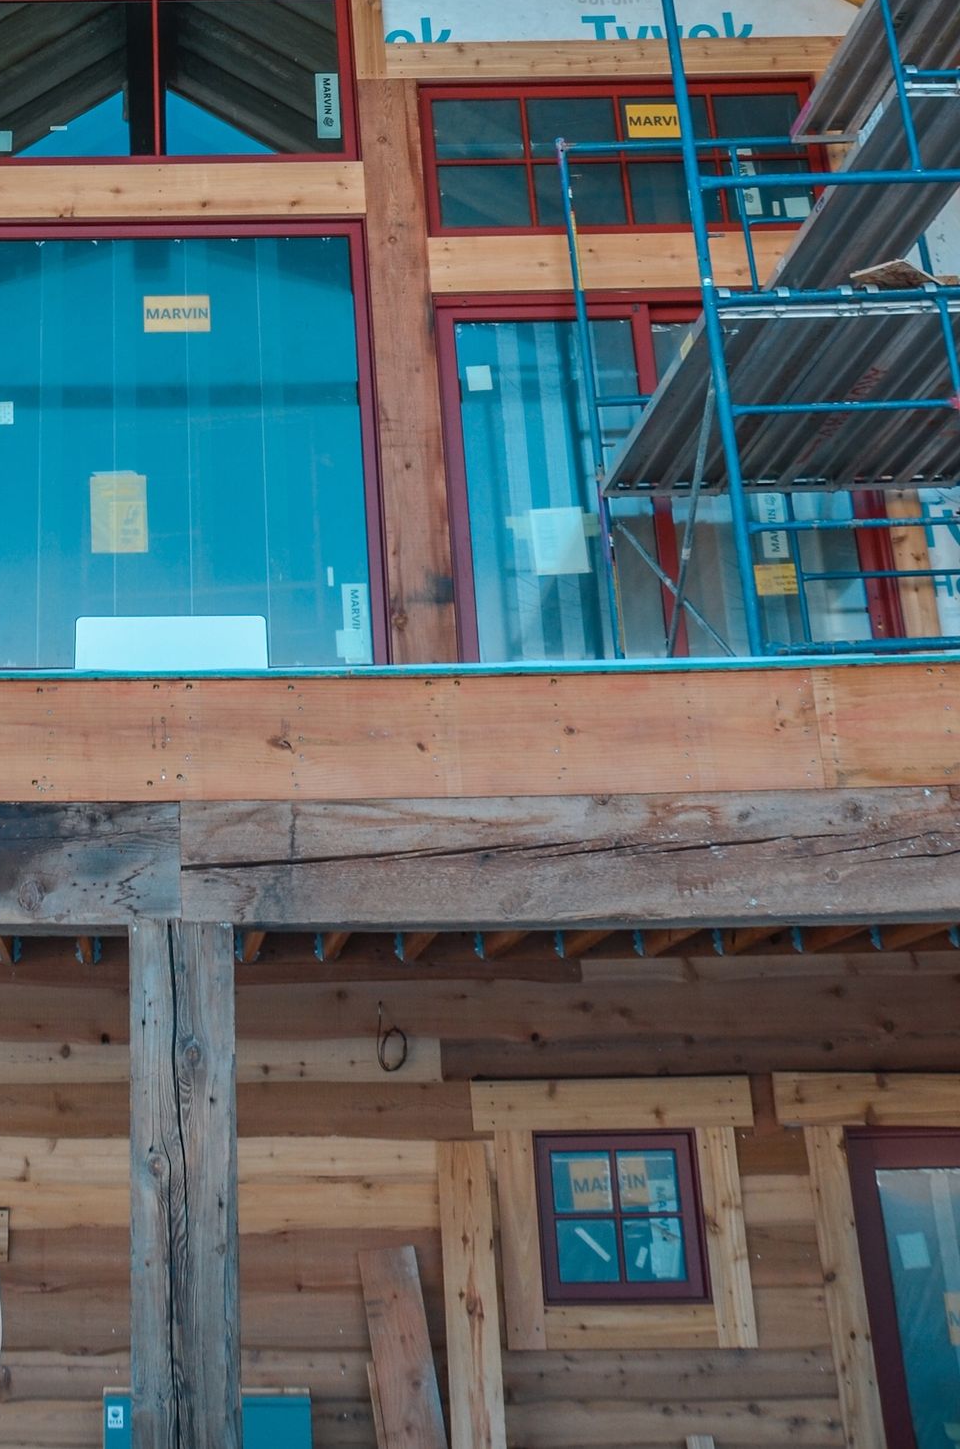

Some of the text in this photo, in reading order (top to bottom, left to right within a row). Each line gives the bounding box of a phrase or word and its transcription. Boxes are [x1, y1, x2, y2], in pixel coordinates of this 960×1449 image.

[323, 78, 332, 115] MARVIN
[146, 308, 209, 319] MARVIN
[350, 589, 361, 630] MARVI
